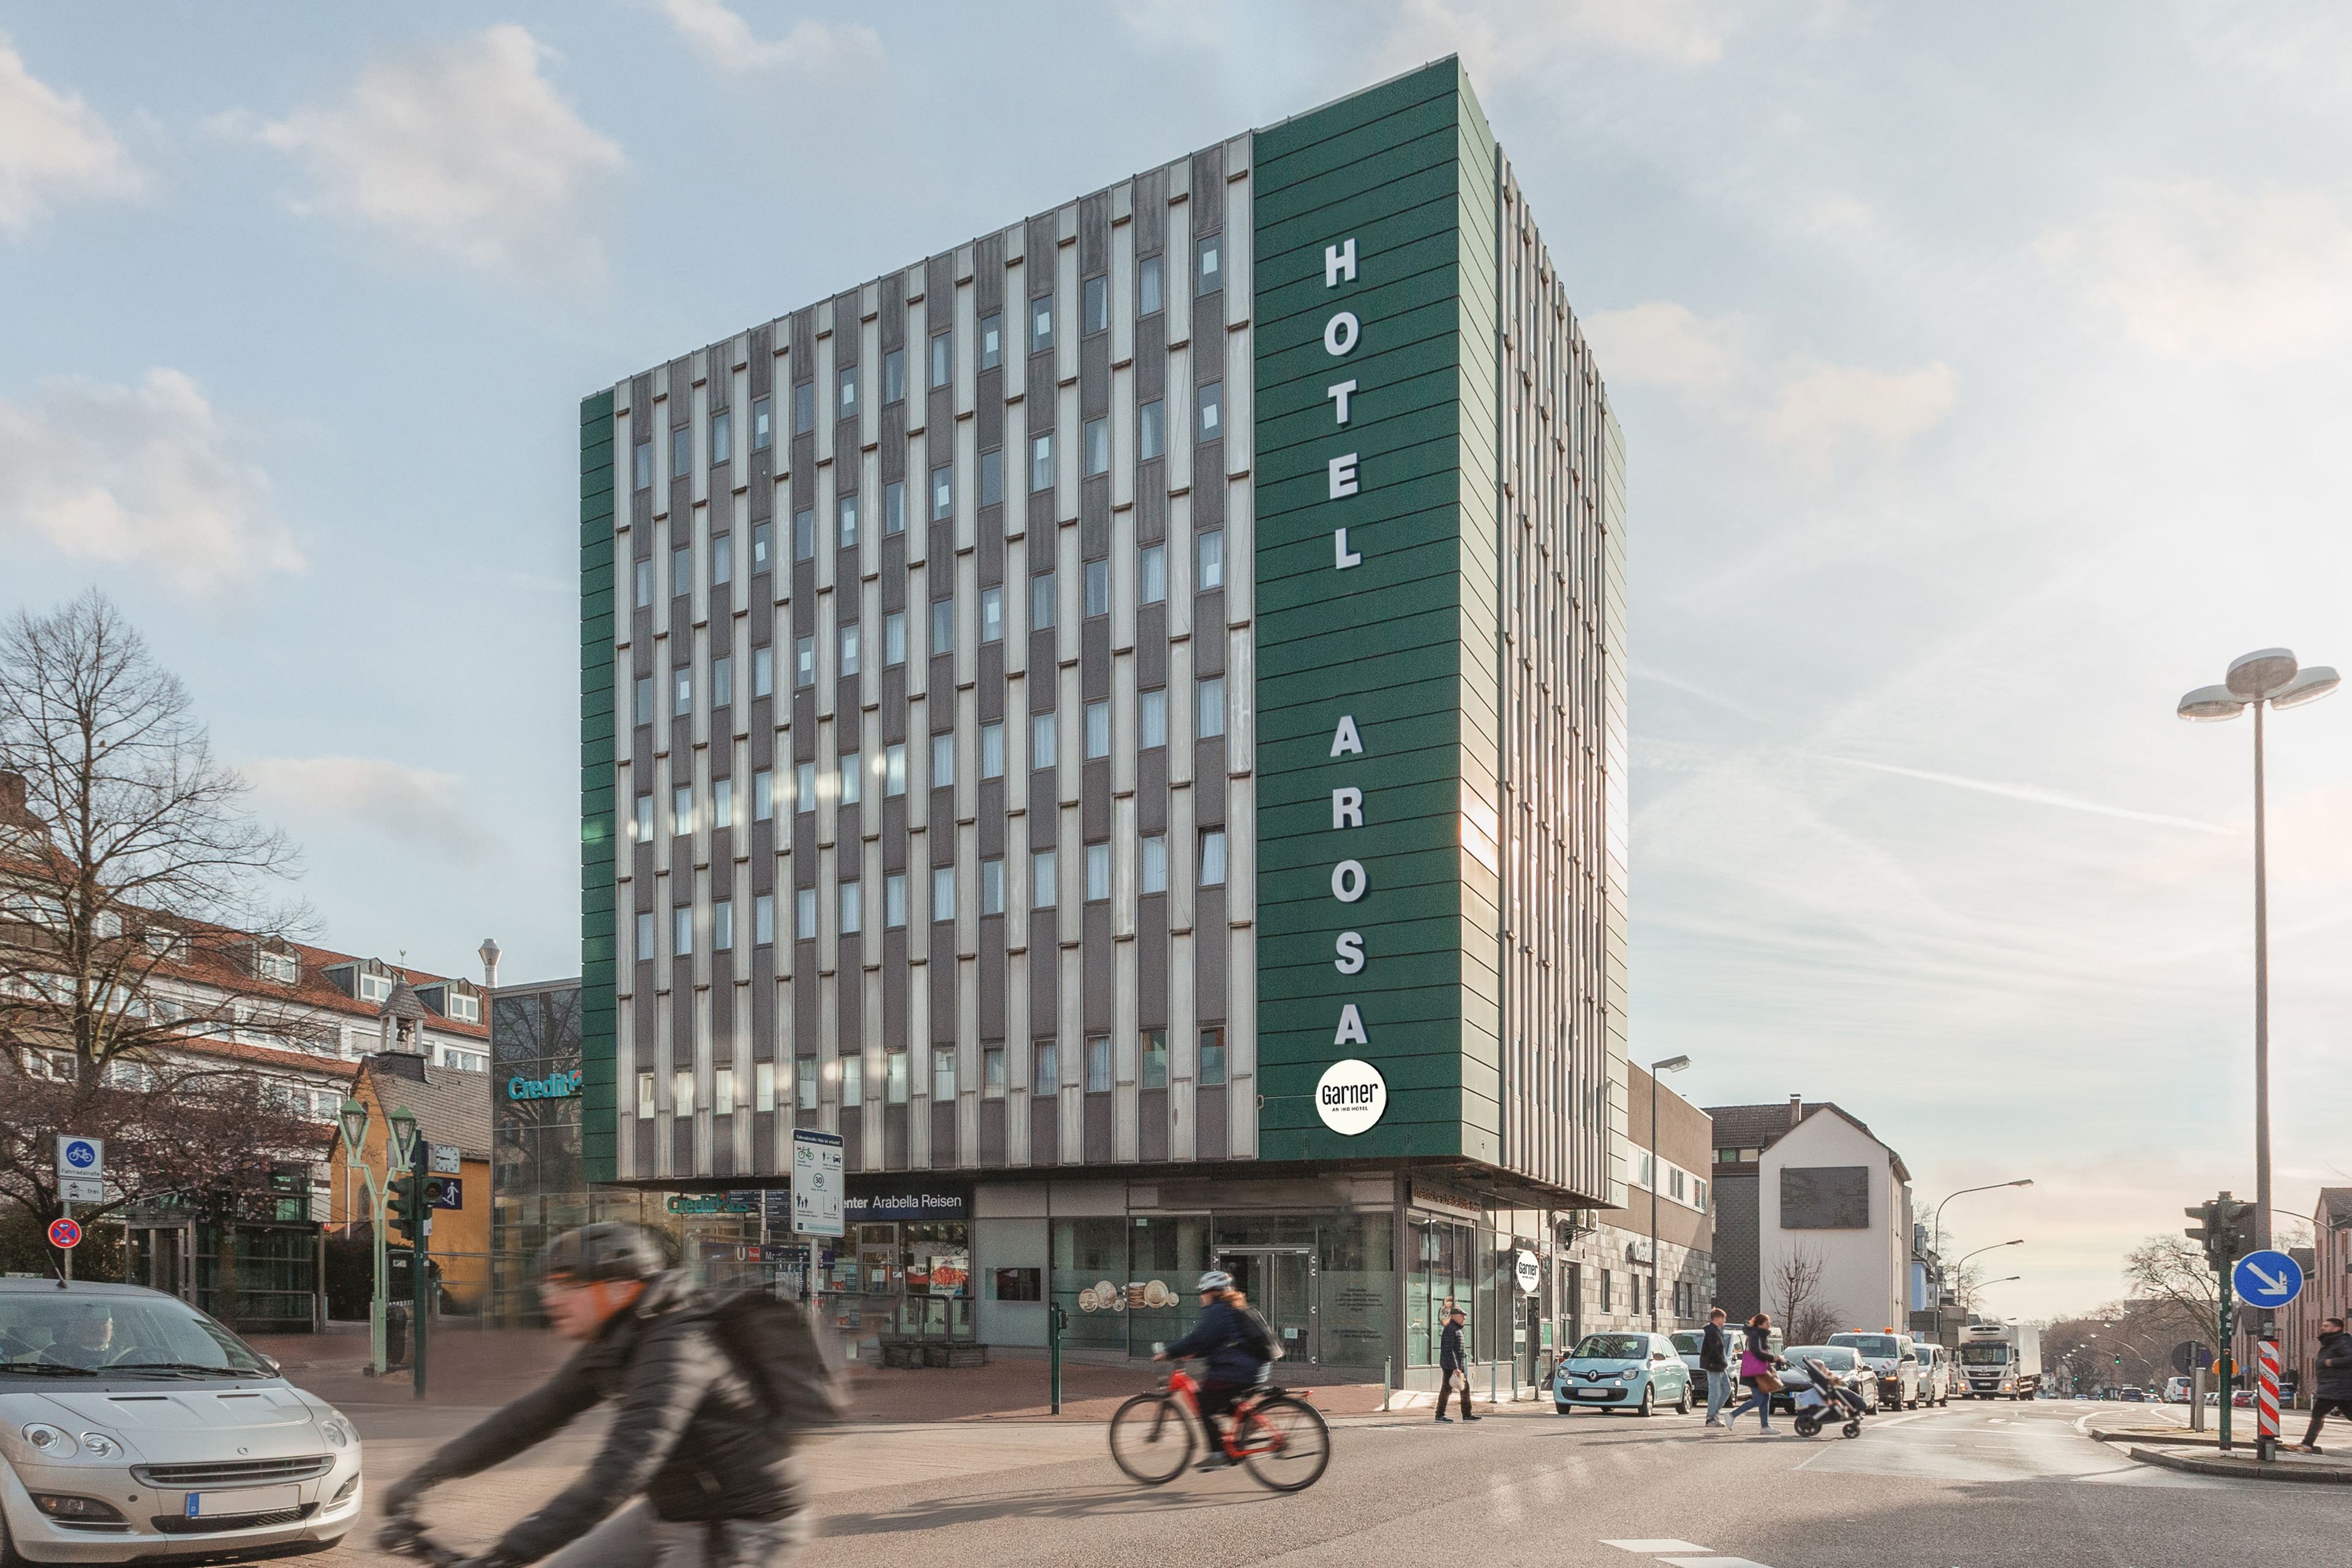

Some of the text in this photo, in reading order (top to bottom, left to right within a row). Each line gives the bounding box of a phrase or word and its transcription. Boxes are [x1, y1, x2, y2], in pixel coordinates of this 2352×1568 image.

[1324, 238, 1362, 570] HOTEL
[1330, 715, 1368, 1045] AROSA
[1322, 1083, 1379, 1106] Garner
[61, 1168, 100, 1177] Fahrradstraße
[872, 1195, 919, 1208] Arabella
[921, 1194, 962, 1208] Reisen
[736, 1247, 746, 1261] U
[1519, 1262, 1539, 1276] Garner
